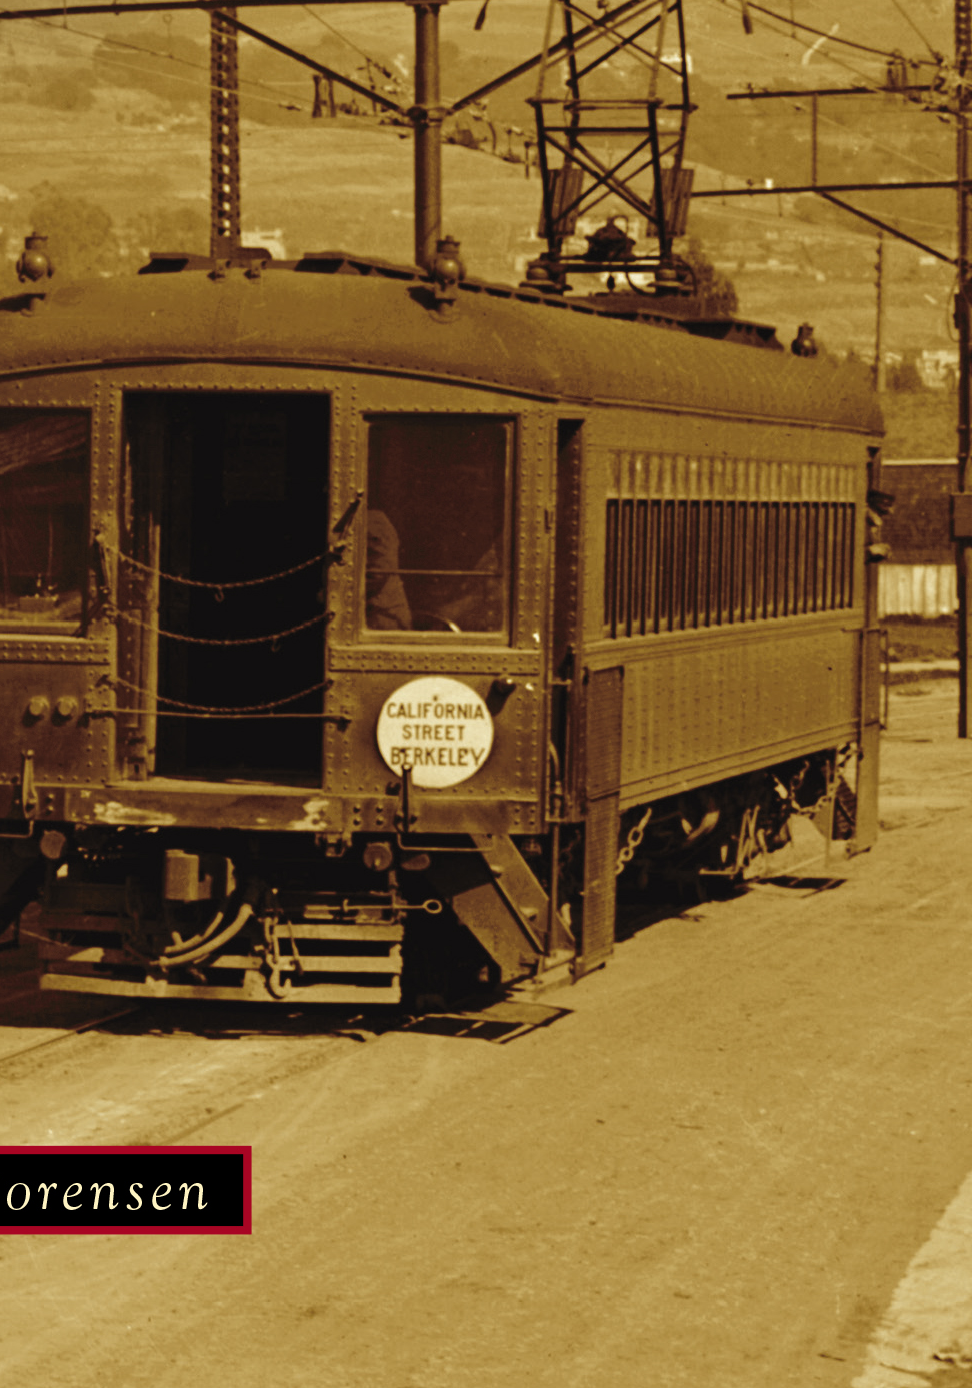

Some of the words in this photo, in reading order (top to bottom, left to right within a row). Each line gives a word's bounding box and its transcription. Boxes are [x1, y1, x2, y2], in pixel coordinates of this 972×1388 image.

[387, 702, 485, 719] CALIFORNIA
[402, 725, 465, 741] STREET
[391, 747, 485, 766] BERKELEY
